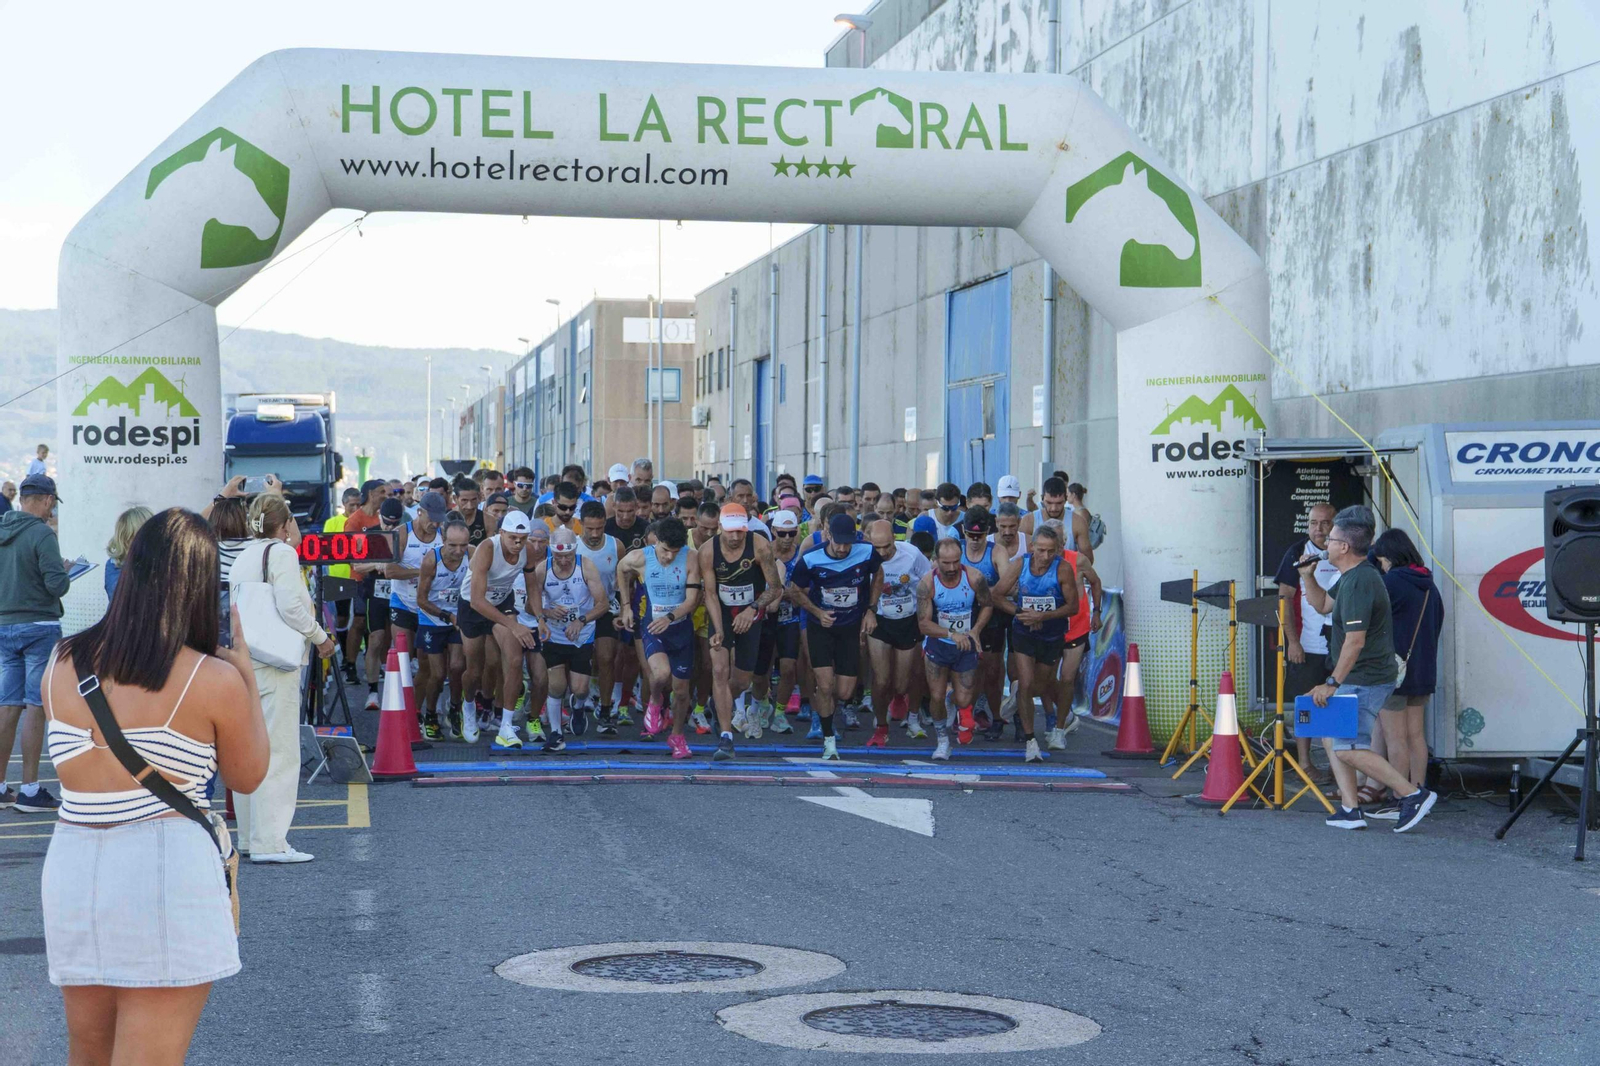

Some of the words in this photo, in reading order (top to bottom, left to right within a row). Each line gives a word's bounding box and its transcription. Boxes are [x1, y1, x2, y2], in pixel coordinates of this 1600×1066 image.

[341, 83, 555, 140] HOTEL
[598, 92, 673, 144] LA
[340, 147, 729, 187] www.hotelrectoral.com
[72, 416, 200, 455] rodespi
[1151, 432, 1247, 463] rodes
[83, 453, 188, 467] www.rodespi.es
[1165, 466, 1247, 479] www.rodespi
[1474, 466, 1593, 476] CRONOMETRAJE
[296, 533, 369, 561] 0:00
[730, 591, 745, 601] 11
[833, 594, 850, 603] 27
[895, 604, 903, 614] 3
[949, 620, 964, 630] 70
